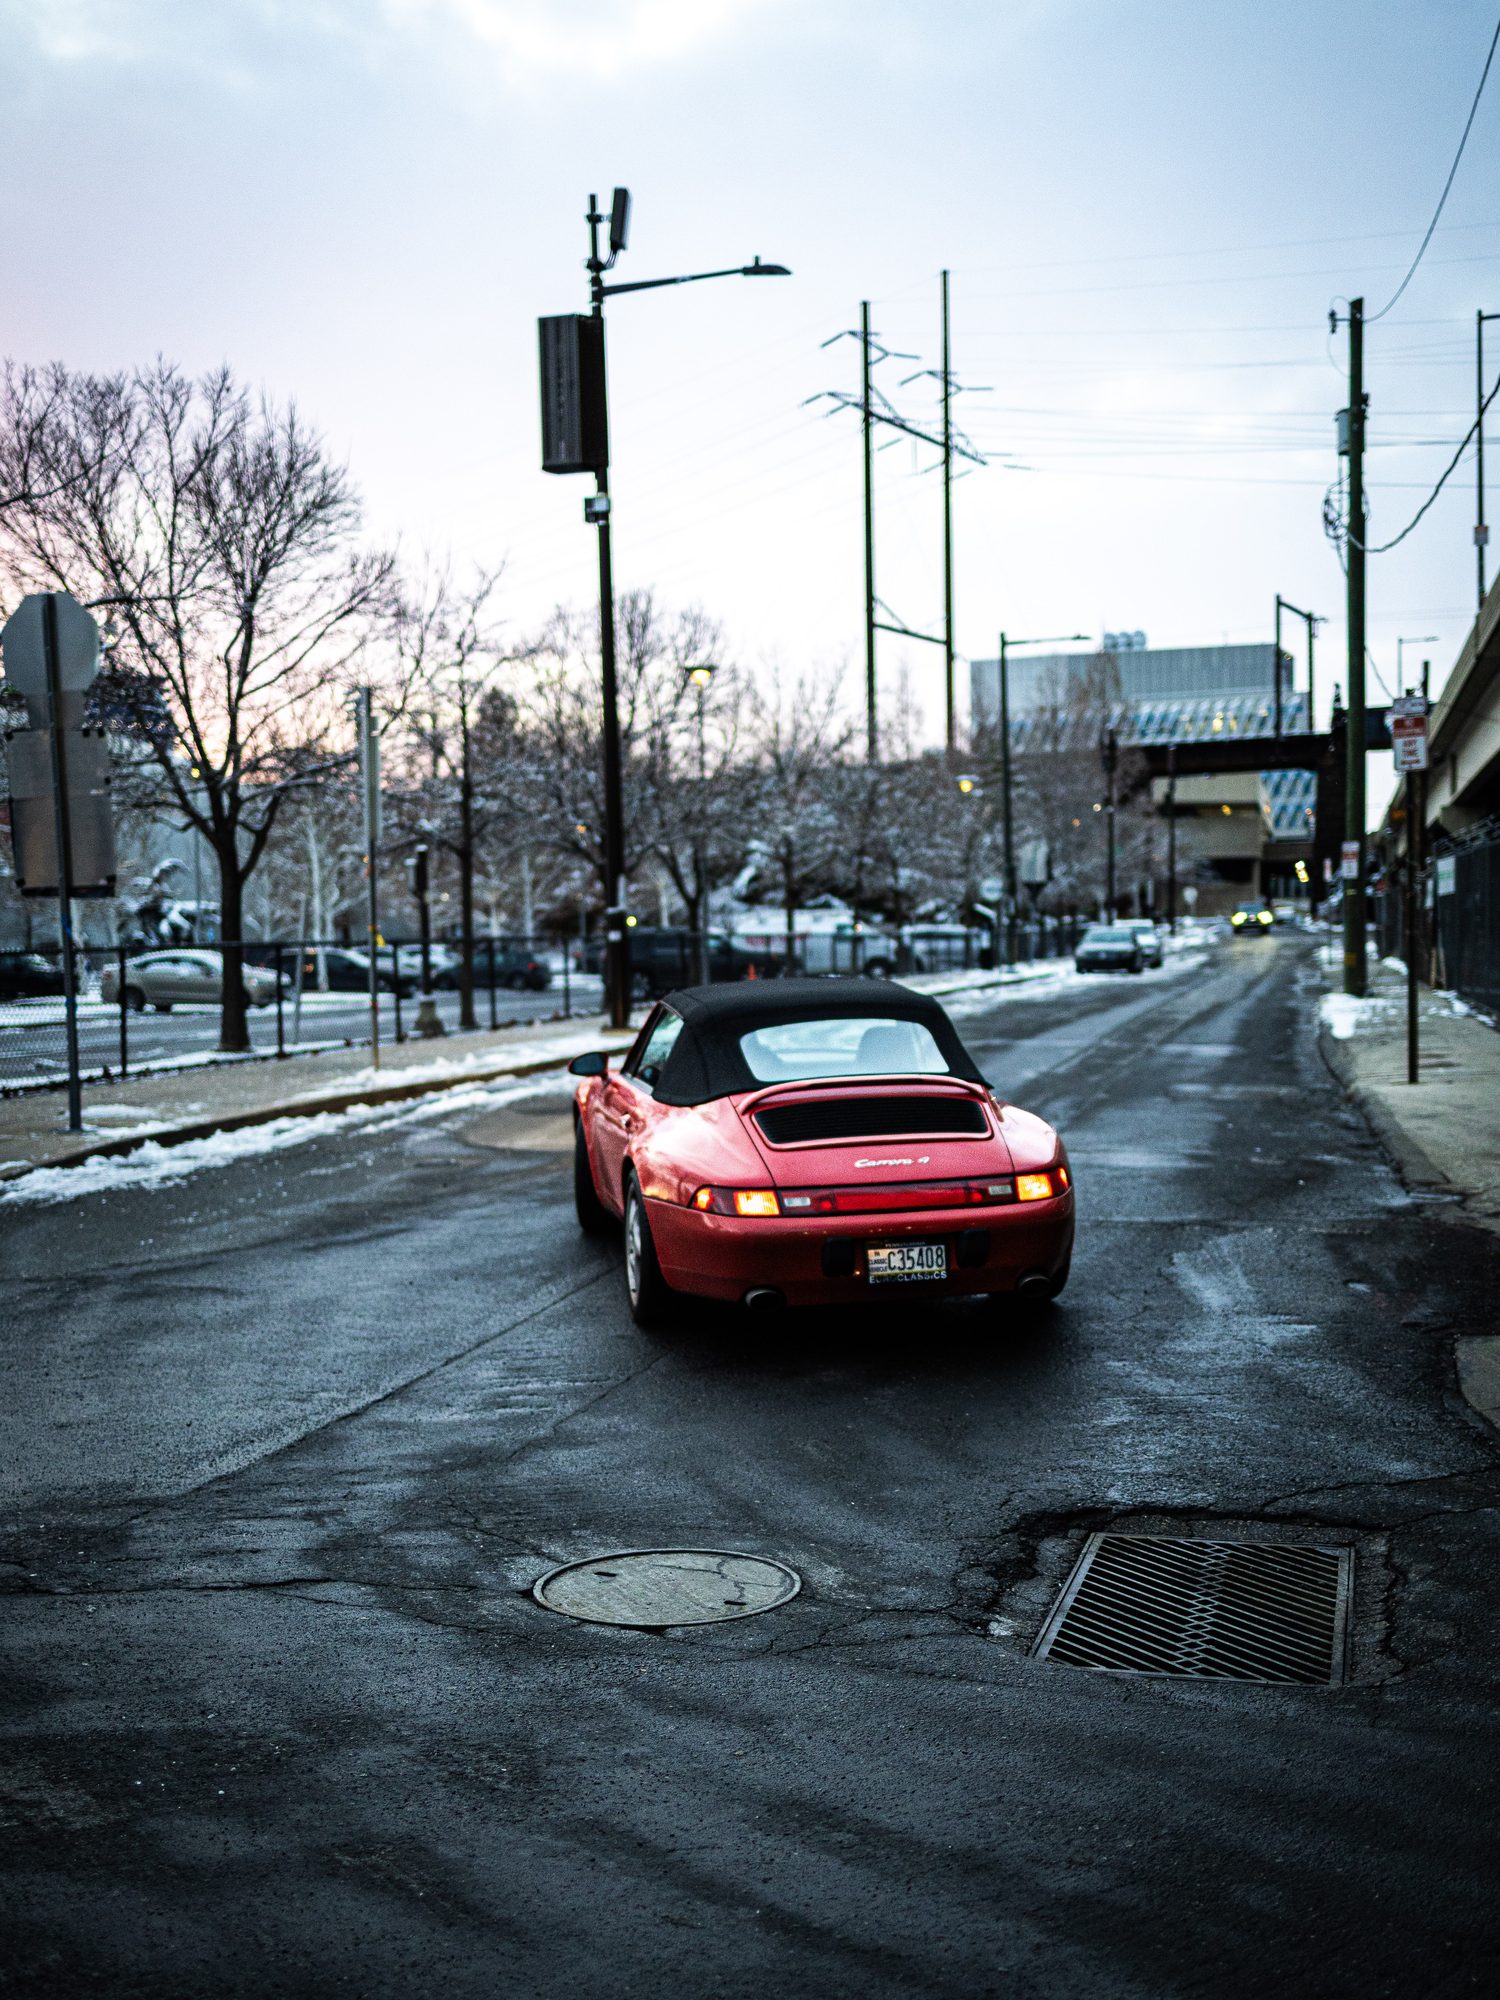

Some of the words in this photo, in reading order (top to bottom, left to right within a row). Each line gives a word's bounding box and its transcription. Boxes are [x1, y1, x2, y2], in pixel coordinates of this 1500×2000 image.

[854, 1158, 913, 1168] Carrera
[917, 1156, 930, 1164] 4
[887, 1247, 944, 1271] C35408
